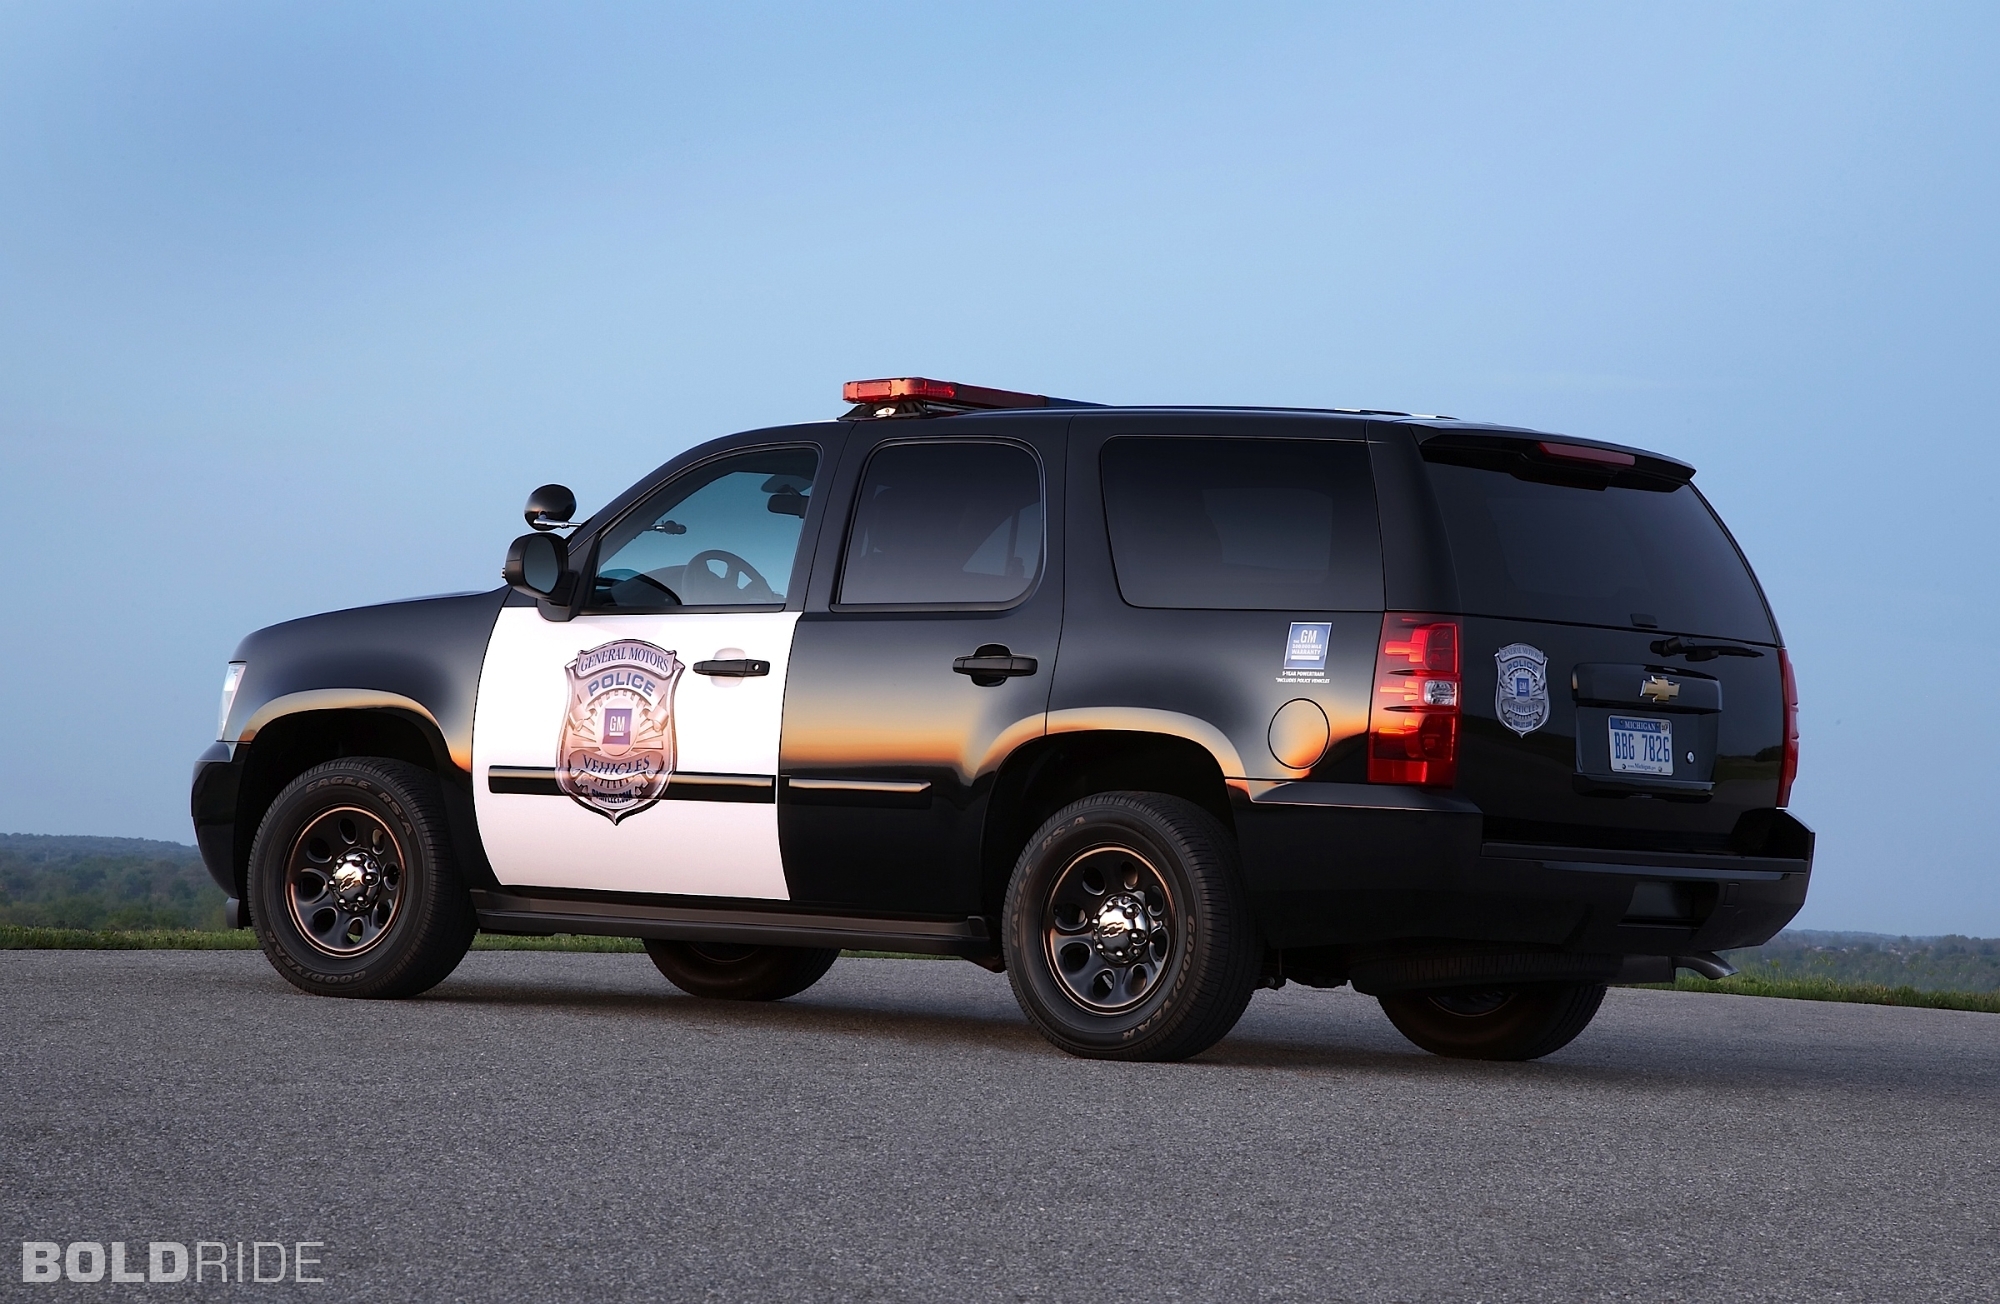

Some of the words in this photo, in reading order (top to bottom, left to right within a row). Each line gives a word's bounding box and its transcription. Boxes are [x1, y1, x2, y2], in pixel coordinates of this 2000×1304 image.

[1300, 629, 1317, 643] GM
[580, 646, 627, 672] GENERAL
[628, 646, 669, 673] MOTORS
[1507, 660, 1539, 672] POLICE
[588, 672, 656, 697] POLICE
[1508, 700, 1540, 712] VEHICLES
[609, 715, 626, 732] GM
[1624, 720, 1656, 731] MICHIGAN
[1614, 732, 1635, 760] BBG
[1642, 734, 1670, 762] 7826
[582, 754, 651, 776] VEHICLES
[305, 775, 372, 794] EAGLE
[1011, 858, 1033, 948] EAGLE
[265, 930, 366, 984] GOODYEAR
[1122, 915, 1196, 1041] GOODYEAR
